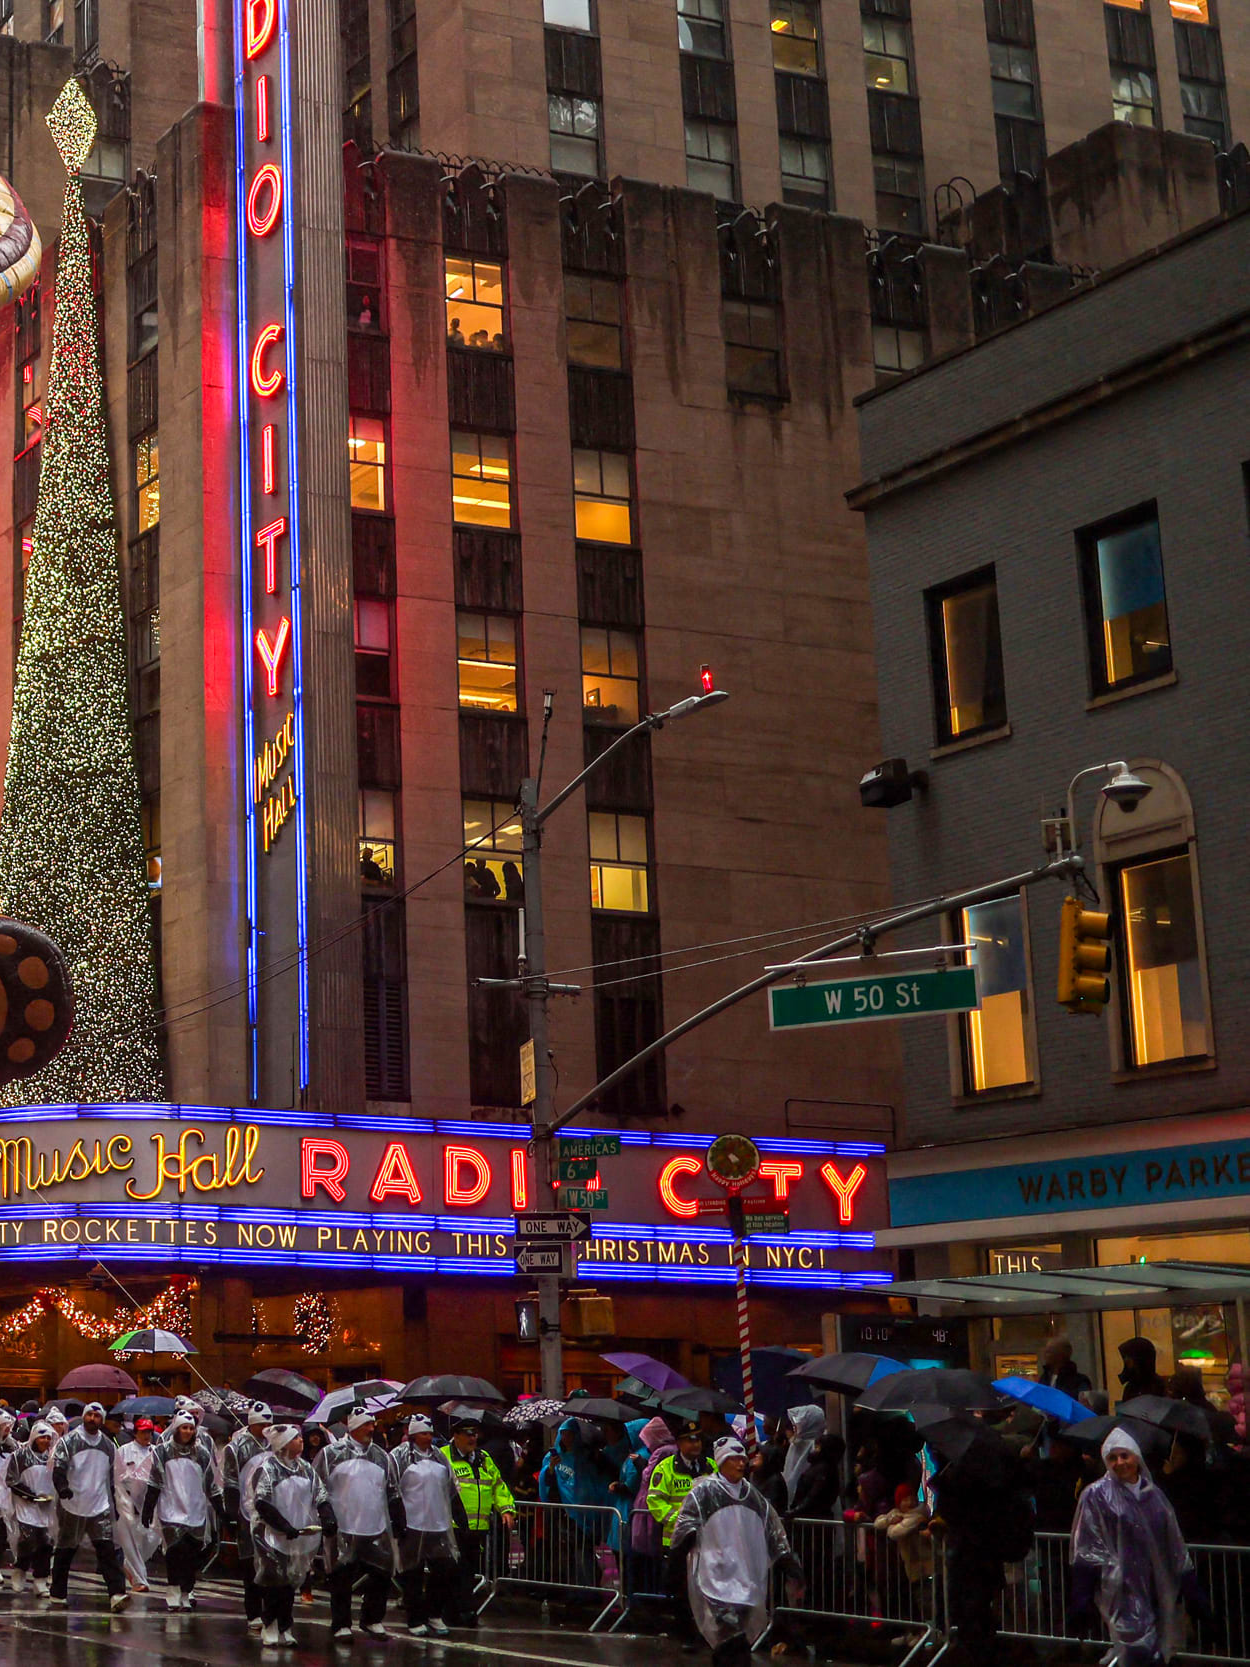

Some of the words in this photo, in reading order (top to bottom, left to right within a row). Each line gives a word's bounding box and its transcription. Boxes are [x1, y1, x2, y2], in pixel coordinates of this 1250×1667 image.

[251, 322, 292, 697] CITY
[824, 988, 842, 1015] W
[853, 984, 884, 1012] 50
[895, 981, 921, 1008] St
[124, 1122, 265, 1201] Hall
[562, 1142, 617, 1157] AMERICAS
[300, 1136, 601, 1211] RADI
[659, 1154, 868, 1225] CTY
[566, 1163, 576, 1179] 6
[1017, 1165, 1127, 1204] WARBY
[568, 1190, 579, 1207] W
[580, 1190, 594, 1208] 50
[595, 1191, 606, 1201] ST
[525, 1221, 548, 1233] ONE
[557, 1221, 580, 1233] WAY
[43, 1218, 218, 1244] ROCKETTES
[237, 1223, 298, 1248] NOW
[317, 1226, 432, 1254] PLAYING
[451, 1232, 508, 1257] THIS
[766, 1246, 825, 1269] NYC!
[519, 1253, 534, 1266] ONE
[540, 1253, 556, 1265] WAY
[673, 1479, 692, 1488] NYPD
